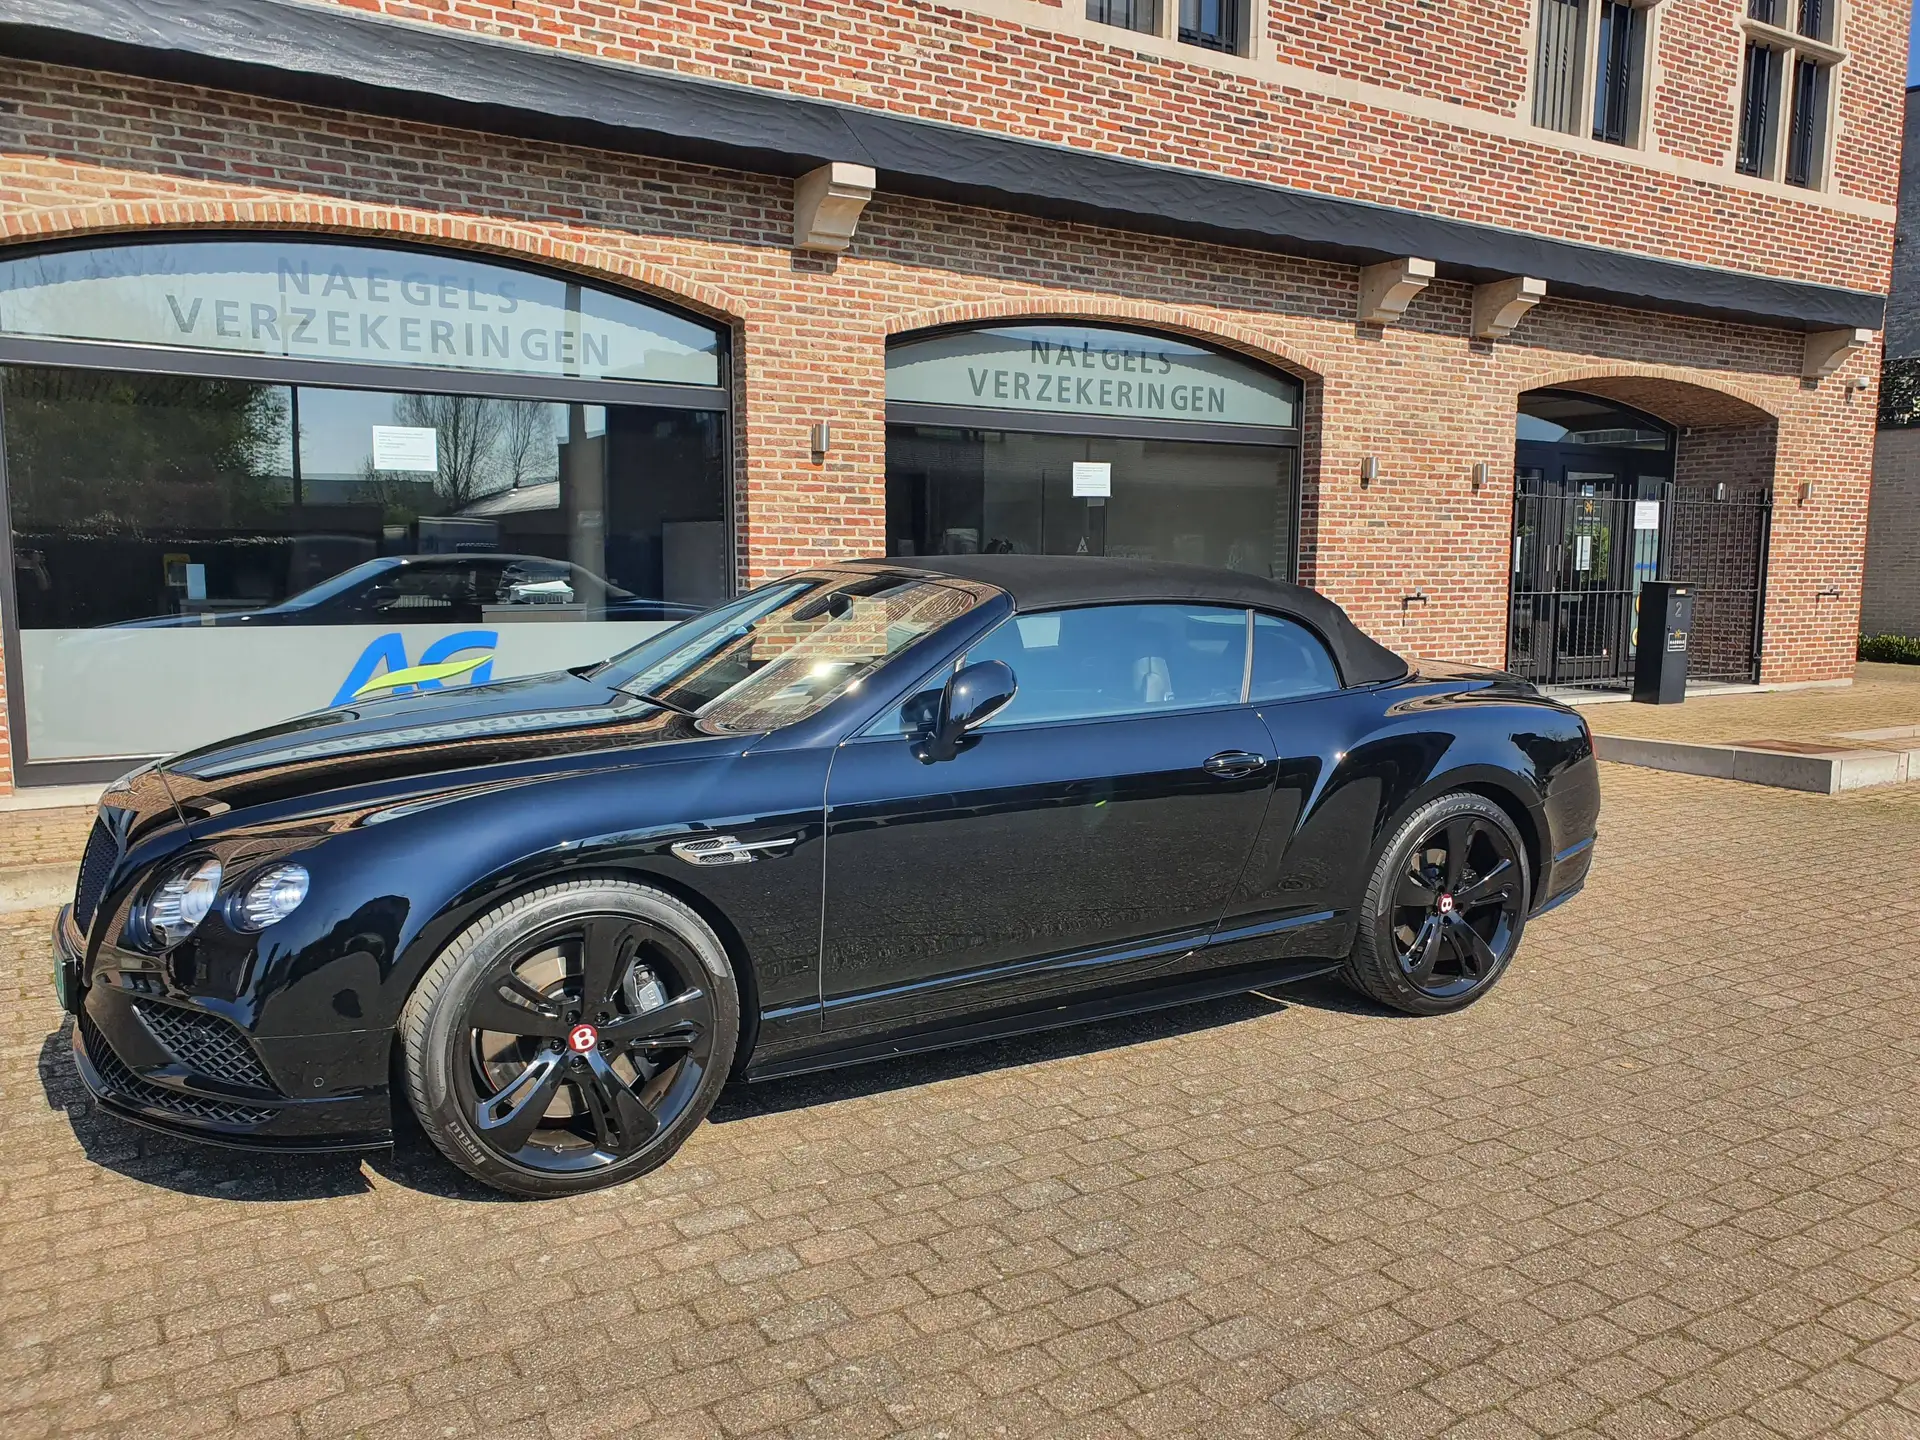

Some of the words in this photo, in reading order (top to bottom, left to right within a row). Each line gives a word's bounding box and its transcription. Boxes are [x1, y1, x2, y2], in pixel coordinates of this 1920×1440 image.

[278, 258, 519, 314] NAEGELS
[167, 295, 610, 367] VERZEKERINGEN
[1030, 340, 1172, 375] NAEGELS
[967, 367, 1226, 413] VERZEKERINGEN
[1675, 601, 1682, 617] 2
[330, 630, 499, 707] AG
[571, 1027, 597, 1051] B
[445, 1121, 487, 1165] PIRELLI
